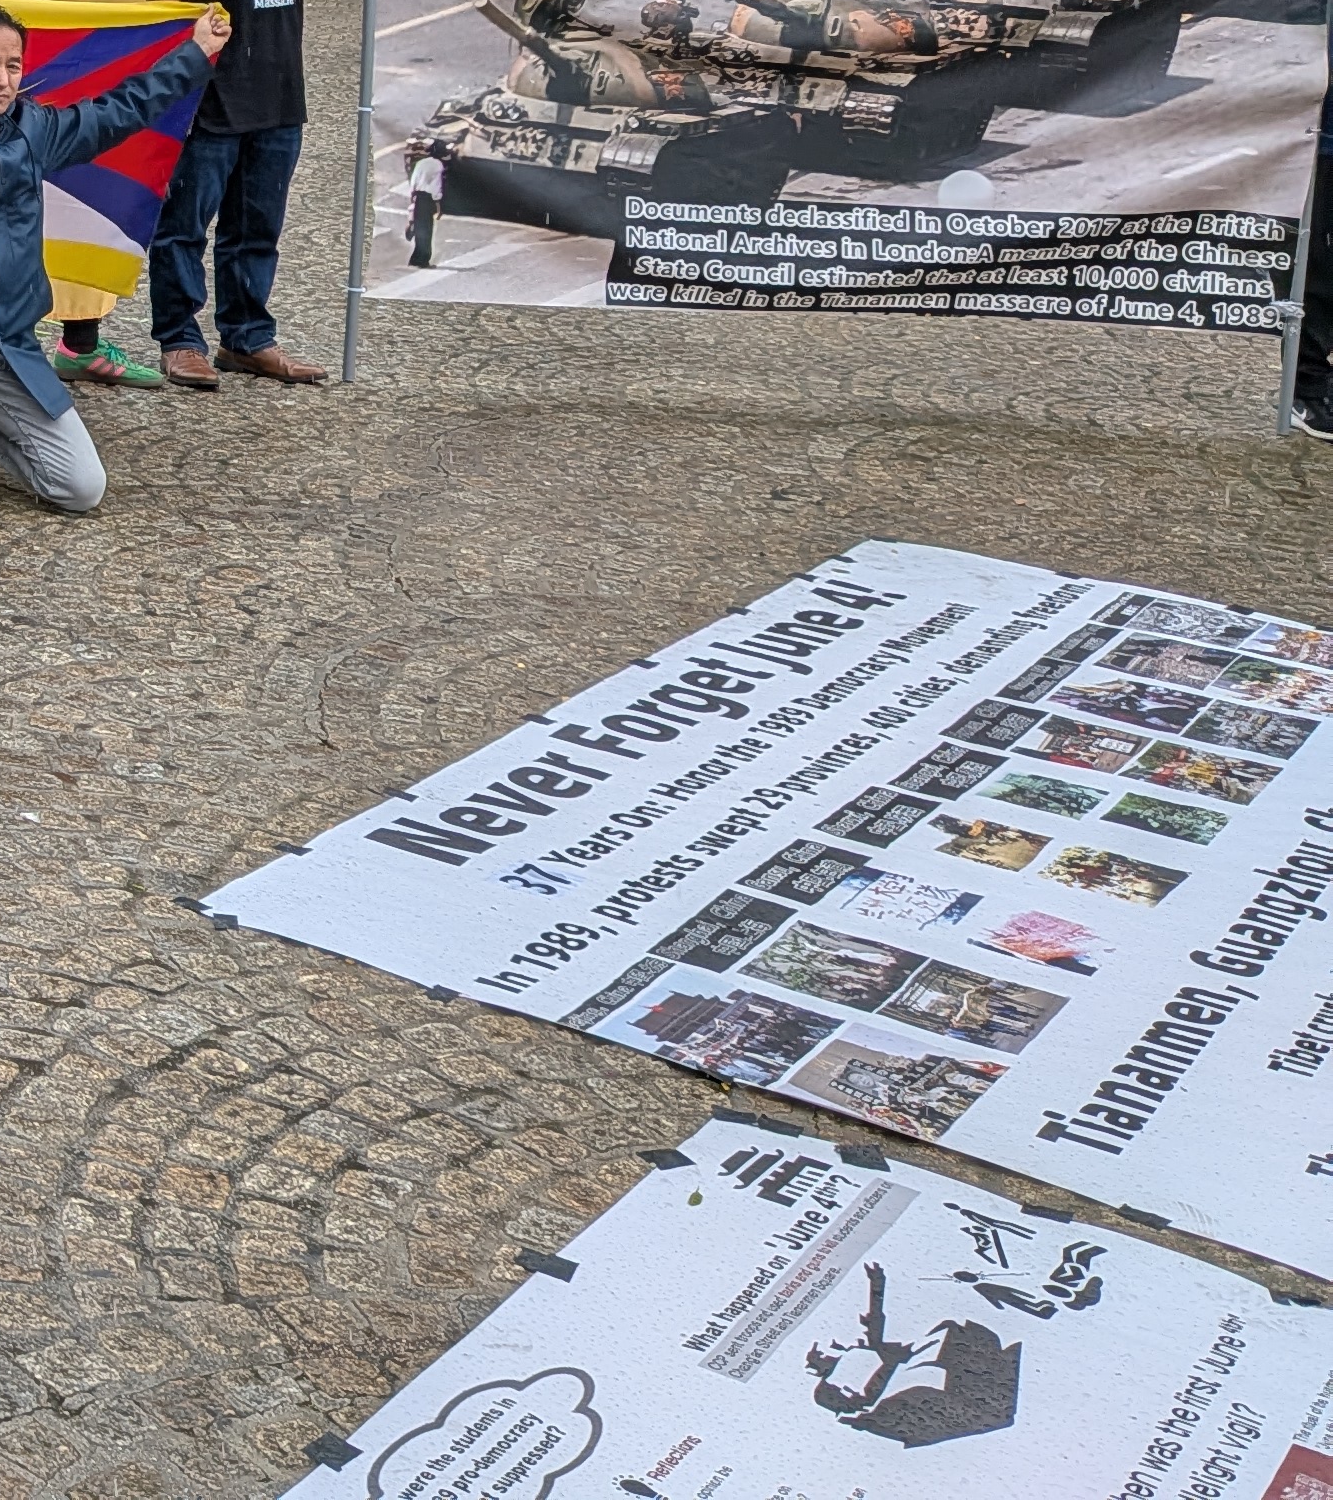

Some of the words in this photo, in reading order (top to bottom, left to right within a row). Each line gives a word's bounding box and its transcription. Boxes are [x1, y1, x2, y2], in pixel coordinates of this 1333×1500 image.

[625, 196, 760, 226] Documents
[765, 202, 909, 233] declassified
[914, 211, 941, 233] in
[945, 212, 1054, 240] October
[1057, 216, 1121, 239] 2017
[1122, 219, 1149, 235] at
[1150, 215, 1190, 234] the
[1196, 213, 1286, 243] British
[625, 225, 727, 253] National
[730, 230, 837, 258] Archives
[841, 237, 868, 260] in
[997, 243, 1099, 264] member
[1100, 238, 1132, 259] of
[1133, 237, 1178, 263] the
[1182, 238, 1291, 270] Chinese
[633, 256, 699, 280] State
[702, 259, 795, 287] Council
[798, 265, 922, 289] estimated
[924, 268, 975, 286] that
[976, 270, 1006, 286] at
[1006, 265, 1068, 286] least
[1072, 264, 1159, 290] 10,000
[1162, 270, 1273, 300] civilians
[607, 283, 668, 301] were
[670, 283, 741, 307] killed
[741, 288, 769, 308] in
[773, 290, 815, 308] the
[819, 291, 950, 310] Tiananmen
[953, 292, 1072, 315] massacre
[1075, 294, 1109, 316] of
[1112, 295, 1175, 321] June
[1177, 299, 1206, 327] 4,
[1212, 300, 1286, 331] 1989.
[363, 751, 613, 867] Never
[549, 657, 777, 761] Forget
[709, 606, 866, 676] June
[810, 579, 908, 611] 4!
[499, 861, 561, 897] 37
[538, 819, 636, 872] Years
[651, 753, 738, 810] Honor
[721, 725, 773, 764] the
[747, 700, 817, 741] 1989
[790, 642, 911, 712] Democracy
[879, 601, 981, 654] Movement
[473, 973, 540, 995] In
[513, 921, 620, 978] 1989,
[591, 847, 708, 927] protests
[685, 804, 774, 858] swept
[752, 786, 795, 812] 29
[774, 731, 894, 796] provinces,
[860, 704, 918, 732] 400
[891, 674, 972, 709] cities,
[936, 617, 1033, 677] demanding
[1011, 582, 1096, 631] freedom.
[1035, 984, 1261, 1156] Tiananmen,
[1266, 1030, 1333, 1078] Tibet
[681, 1319, 729, 1353] What
[712, 1266, 777, 1323] happened
[767, 1253, 792, 1271] on
[1173, 1374, 1223, 1412] first
[425, 1451, 456, 1472] the
[449, 1407, 505, 1455] students
[492, 1397, 518, 1410] in
[1155, 1407, 1201, 1438] the
[1217, 1401, 1267, 1451] vigil?
[451, 1412, 544, 1494] pro-democracy
[491, 1424, 567, 1495] suppressed?
[645, 1434, 704, 1483] Reflections
[714, 1464, 735, 1478] be
[1138, 1437, 1184, 1473] was
